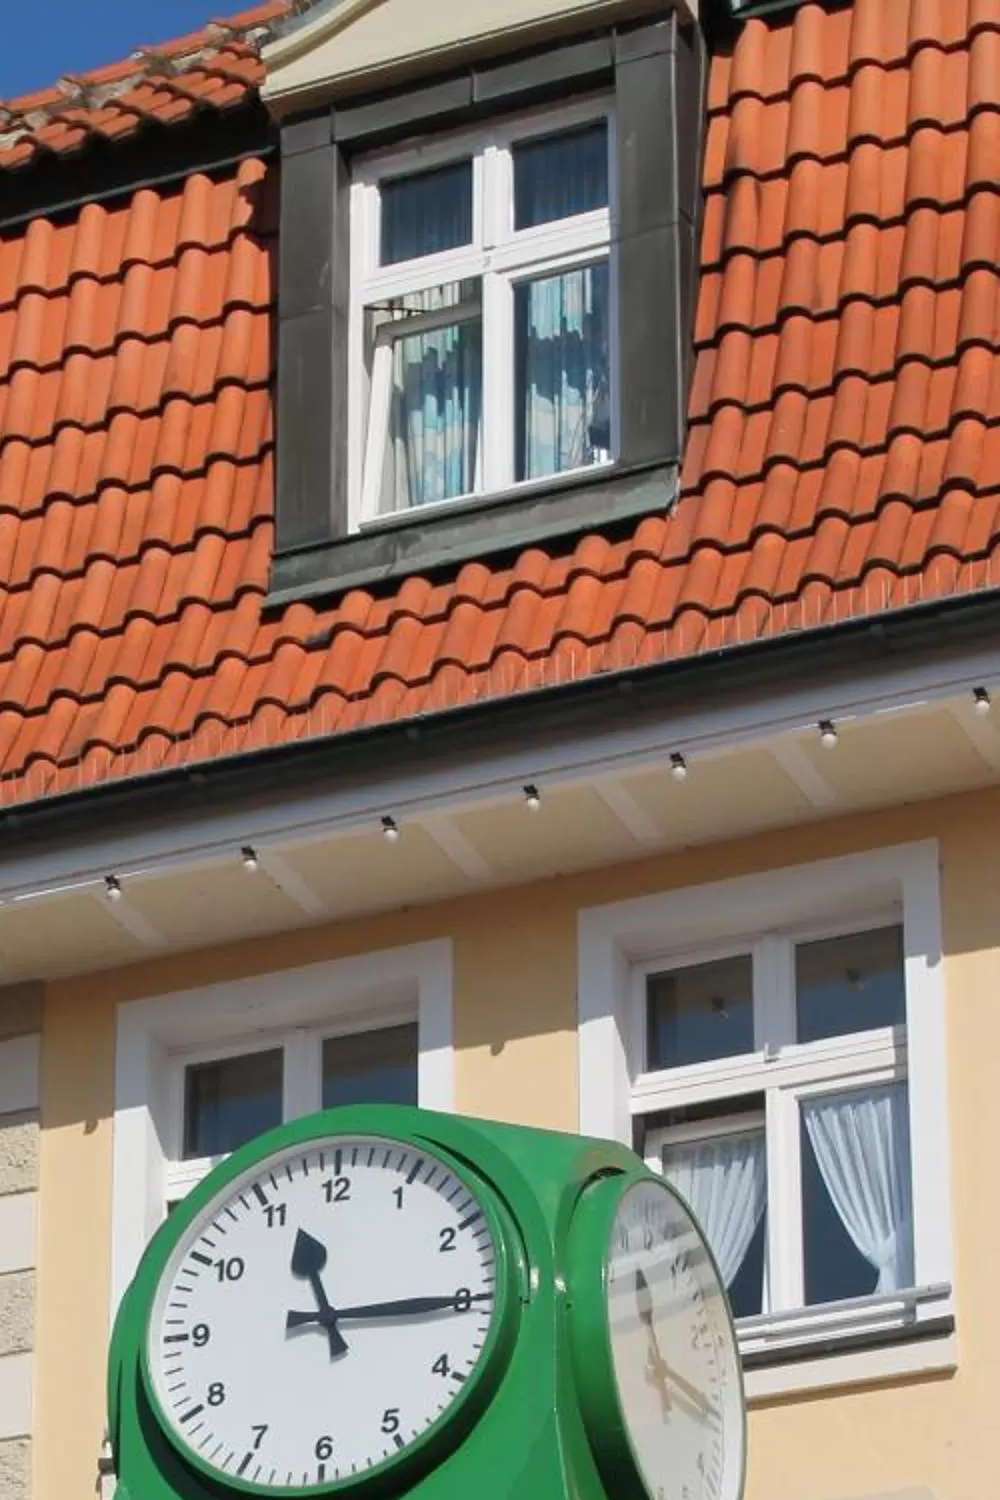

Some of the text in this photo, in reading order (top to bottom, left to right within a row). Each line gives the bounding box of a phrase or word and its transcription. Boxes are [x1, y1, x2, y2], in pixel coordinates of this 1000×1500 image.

[321, 1177, 351, 1204] 12
[392, 1186, 404, 1210] 1
[262, 1203, 287, 1228] 11
[438, 1227, 457, 1251] 2
[214, 1257, 244, 1282] 10
[191, 1323, 210, 1348] 9
[431, 1353, 450, 1378] 4
[207, 1382, 225, 1407] 8
[381, 1408, 400, 1434] 5
[251, 1424, 268, 1450] 7
[314, 1436, 333, 1461] 6
